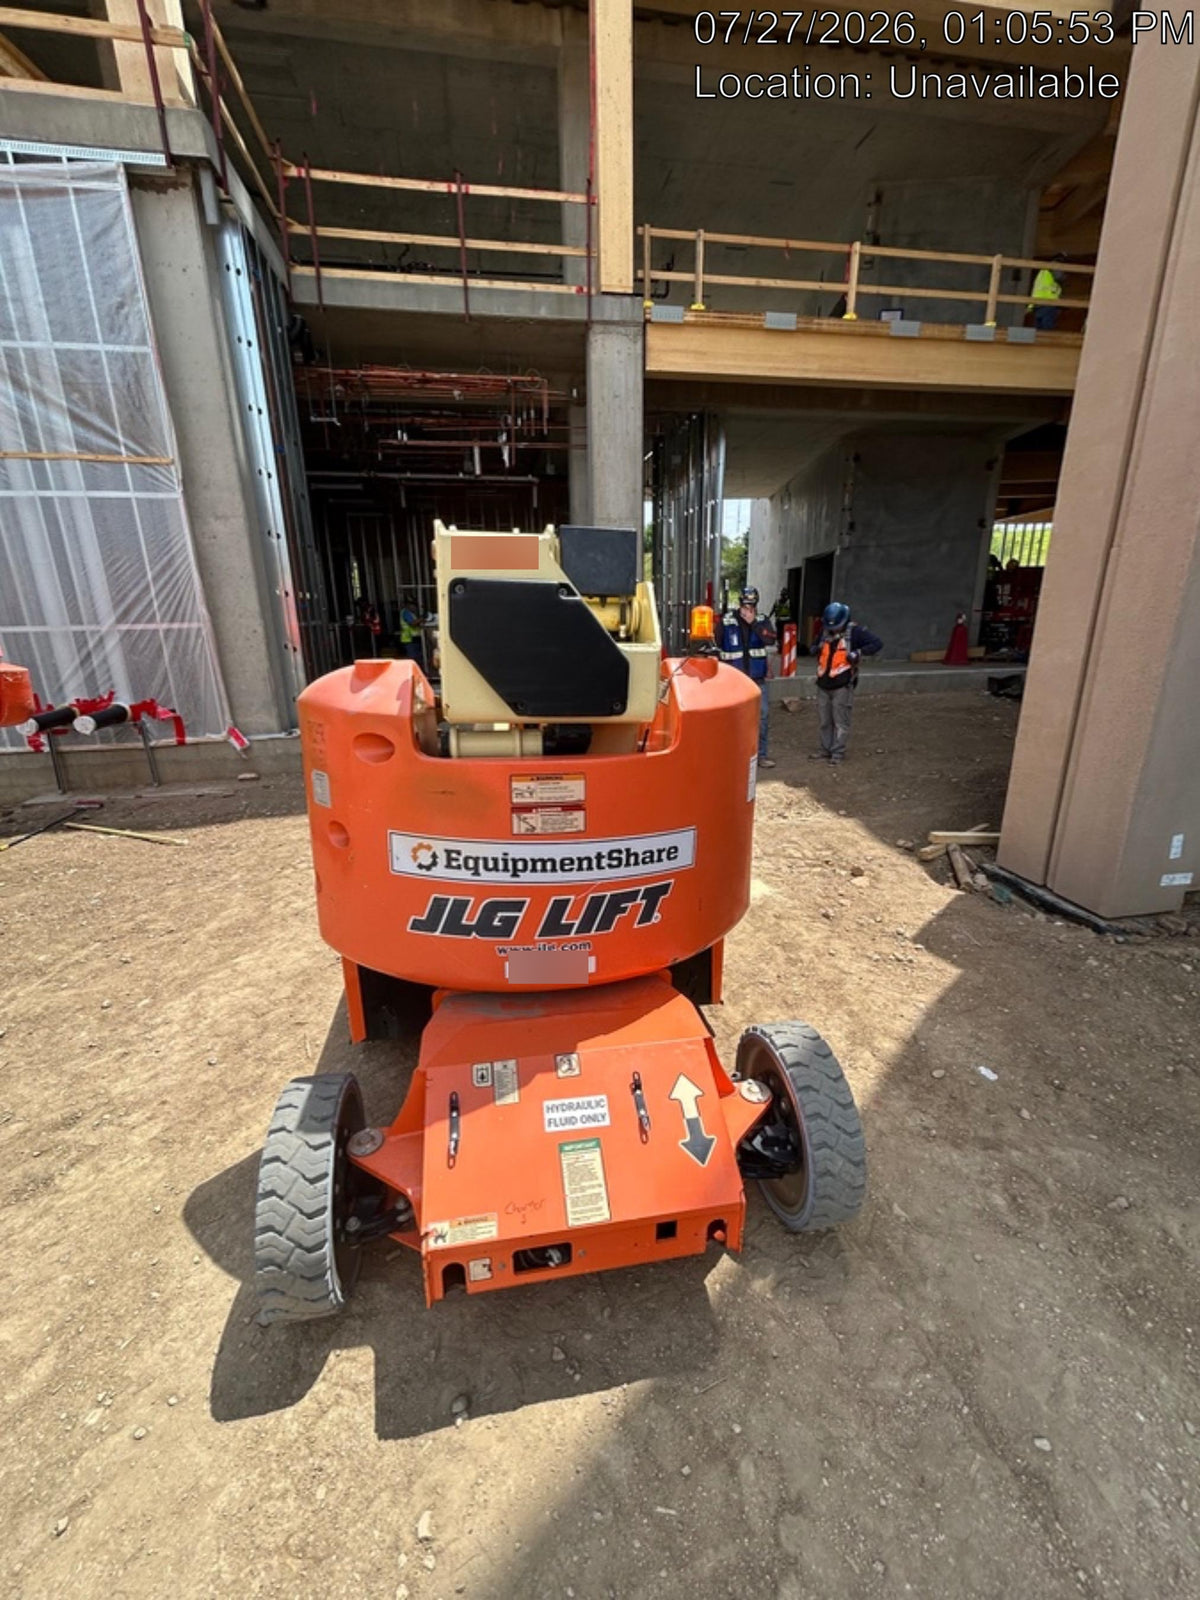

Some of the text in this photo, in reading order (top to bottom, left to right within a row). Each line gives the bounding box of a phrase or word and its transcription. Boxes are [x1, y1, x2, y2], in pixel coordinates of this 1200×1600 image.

[443, 844, 680, 878] EquipmentShare
[407, 879, 675, 940] JLG LIFT
[497, 942, 592, 955] wwwjlgcom
[545, 1098, 606, 1113] HYDRAULIC
[547, 1112, 607, 1128] FLUID ONLY
